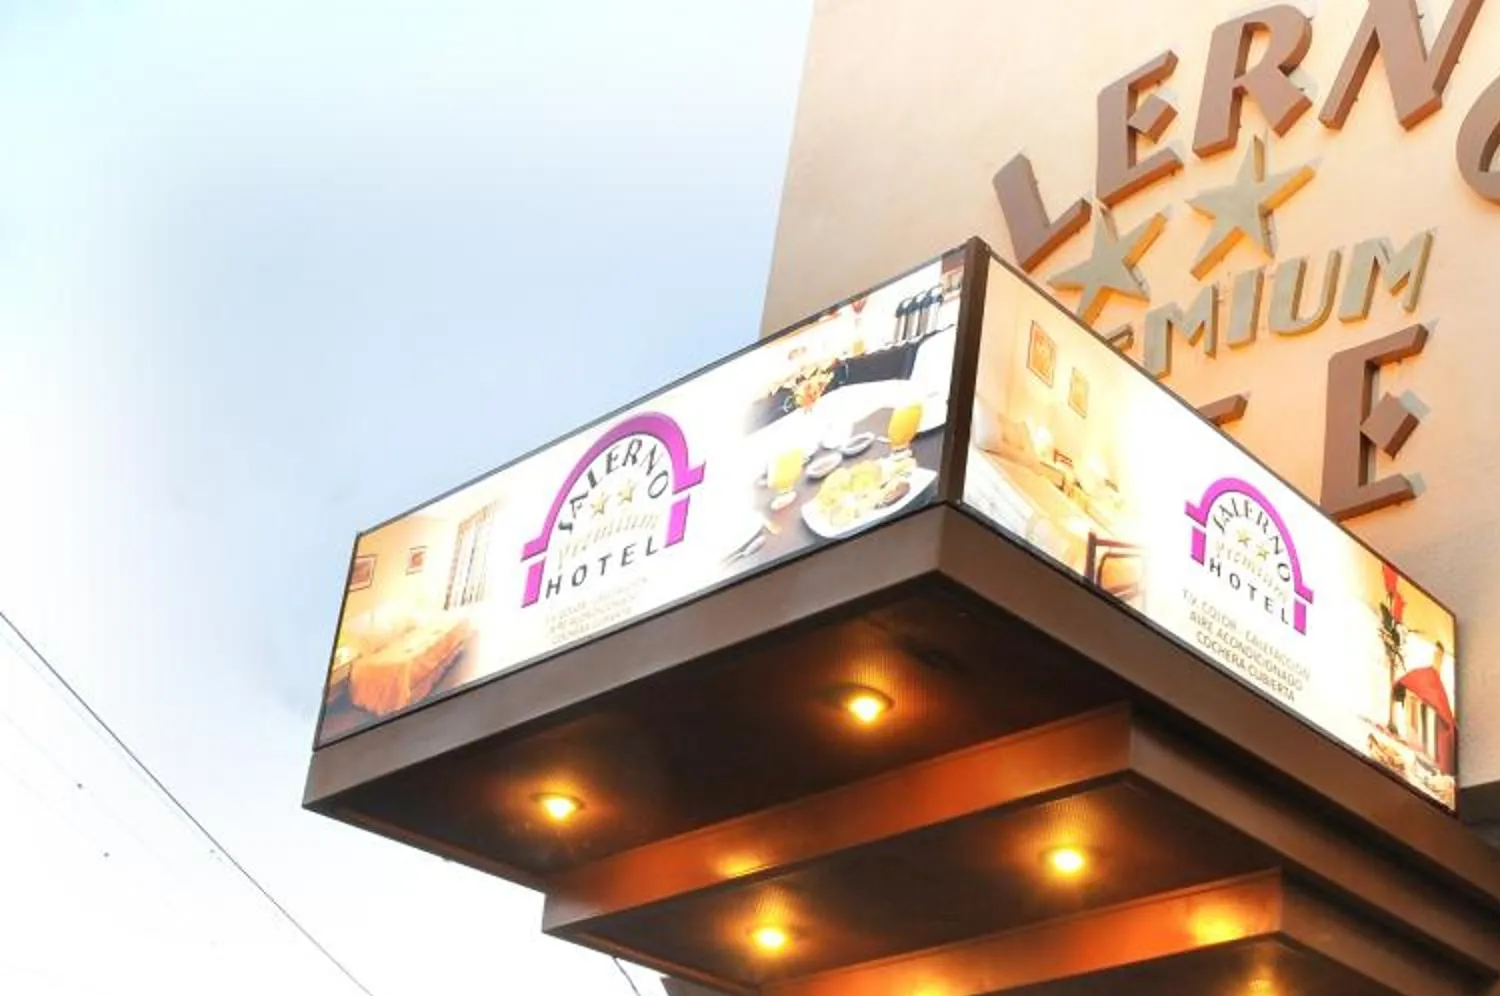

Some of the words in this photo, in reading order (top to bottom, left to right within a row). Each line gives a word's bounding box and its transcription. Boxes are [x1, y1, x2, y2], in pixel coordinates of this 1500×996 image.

[546, 535, 659, 599] HOTEL
[1209, 556, 1289, 625] HOTEL
[1196, 630, 1246, 670] COCHERA
[1248, 664, 1295, 702] CUBIERTA
